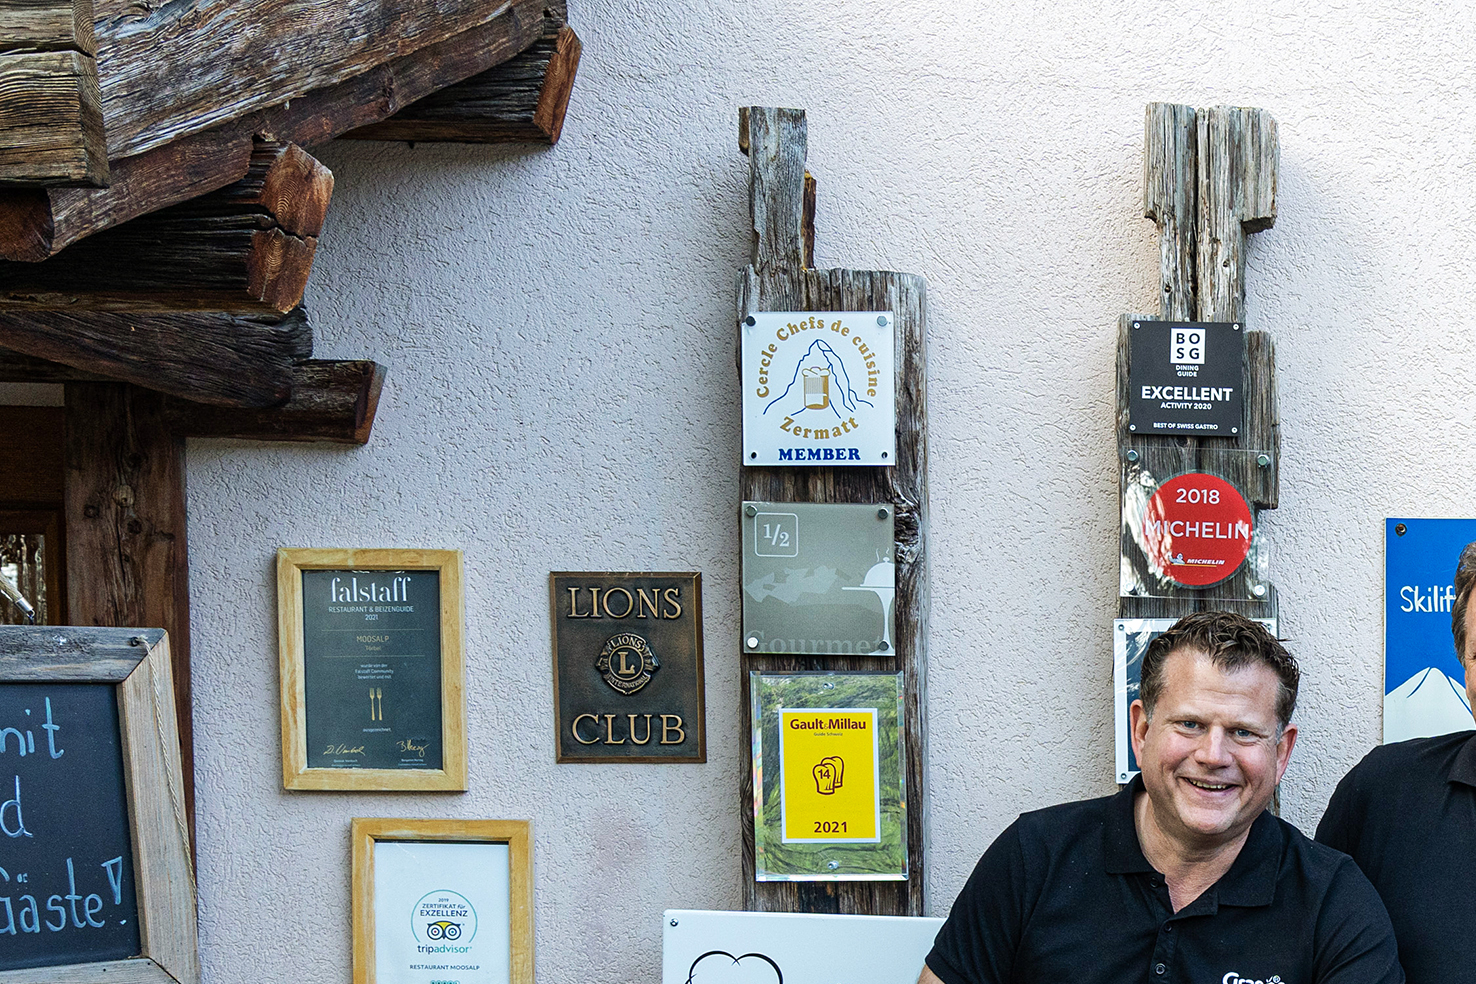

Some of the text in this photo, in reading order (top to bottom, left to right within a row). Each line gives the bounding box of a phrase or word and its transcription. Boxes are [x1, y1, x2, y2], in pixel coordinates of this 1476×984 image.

[756, 316, 880, 398] Cercle Chefs de cuisine
[1141, 386, 1233, 401] EXCELLENT
[1160, 402, 1193, 410] ACTIVITY
[780, 416, 859, 440] Zermatt
[778, 448, 861, 461] MEMBER
[1176, 488, 1220, 505] 2018
[763, 523, 790, 547] 1/2
[1145, 520, 1249, 540] MICHELIN
[331, 576, 411, 602] falstaff
[567, 587, 682, 619] LIONS
[1400, 585, 1456, 612] Skilif
[356, 635, 389, 643] MOOSALP
[610, 635, 642, 649] LIONS
[618, 651, 635, 674] L
[572, 713, 686, 745] CLUB
[818, 769, 831, 780] 14
[814, 821, 848, 833] 2021
[417, 944, 470, 955] tripadvisor
